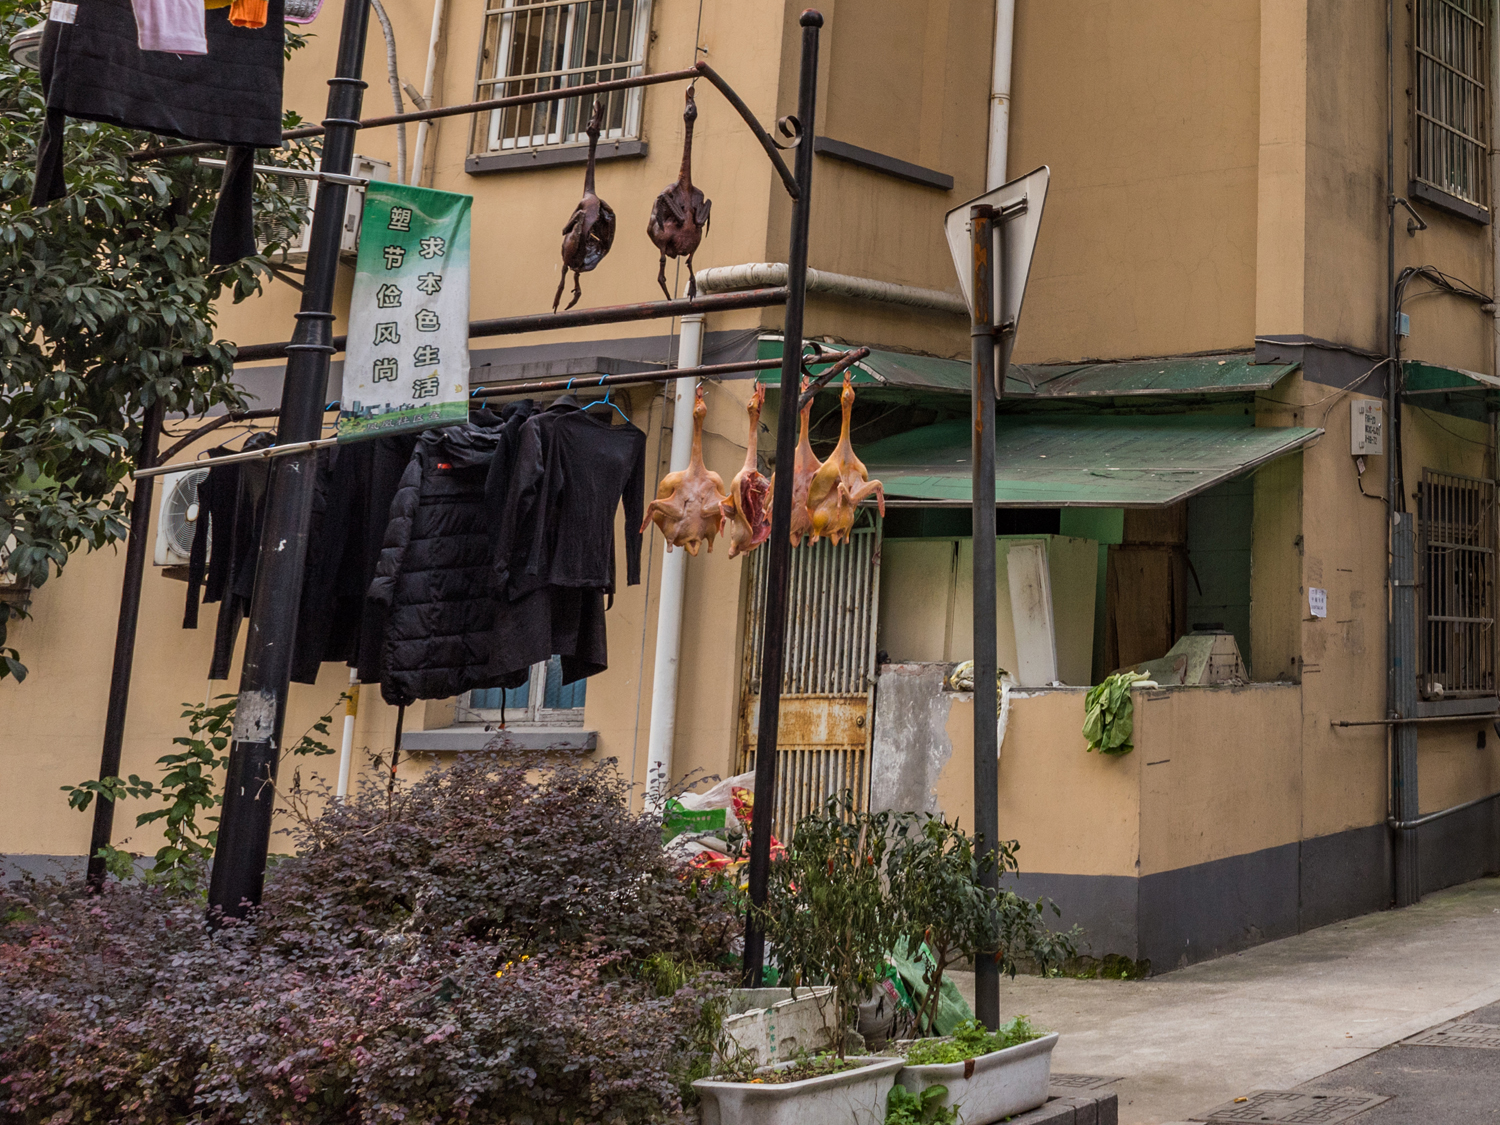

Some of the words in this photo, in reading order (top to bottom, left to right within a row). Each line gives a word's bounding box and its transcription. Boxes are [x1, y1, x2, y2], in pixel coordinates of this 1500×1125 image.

[372, 206, 412, 383] 塑节俭风尚
[412, 236, 445, 399] 求本色生活
